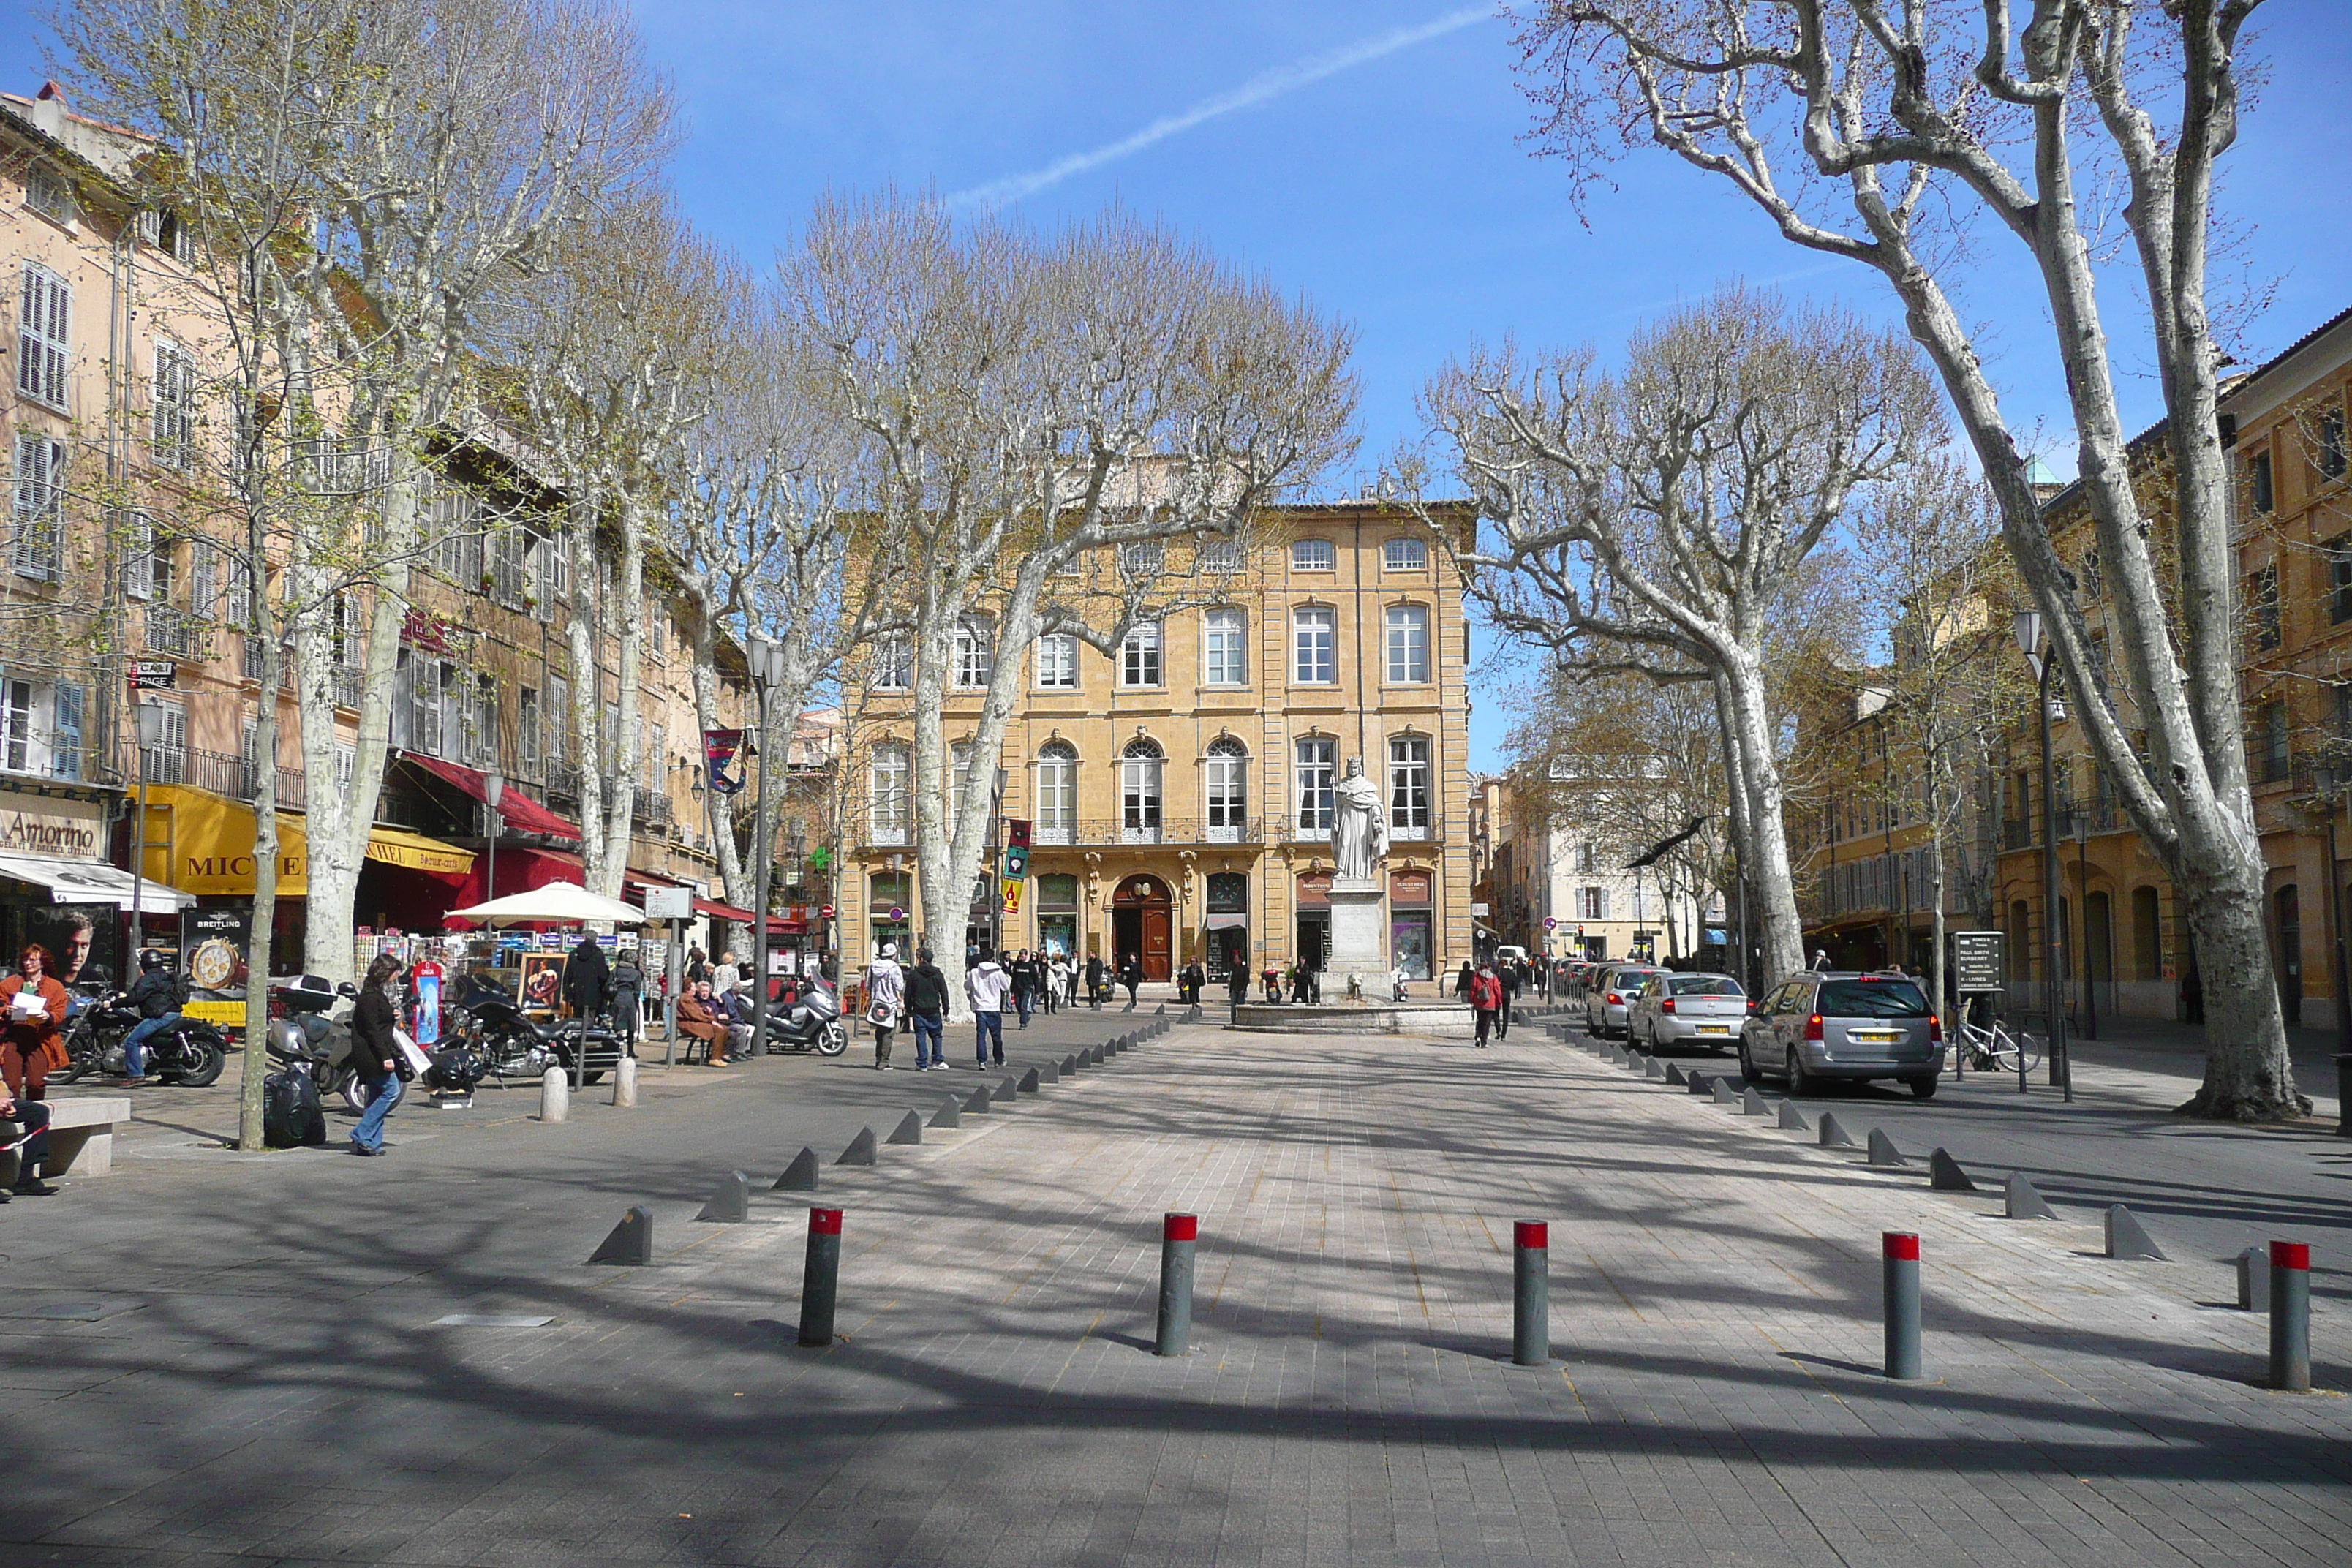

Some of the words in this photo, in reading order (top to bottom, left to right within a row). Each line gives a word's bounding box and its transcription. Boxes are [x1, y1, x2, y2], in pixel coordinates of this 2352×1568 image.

[139, 677, 167, 685] PAGE
[7, 811, 94, 848] Amorino
[37, 845, 64, 853] DELIZIE
[68, 848, 97, 856] D'ITALIA
[187, 857, 309, 875] MICE
